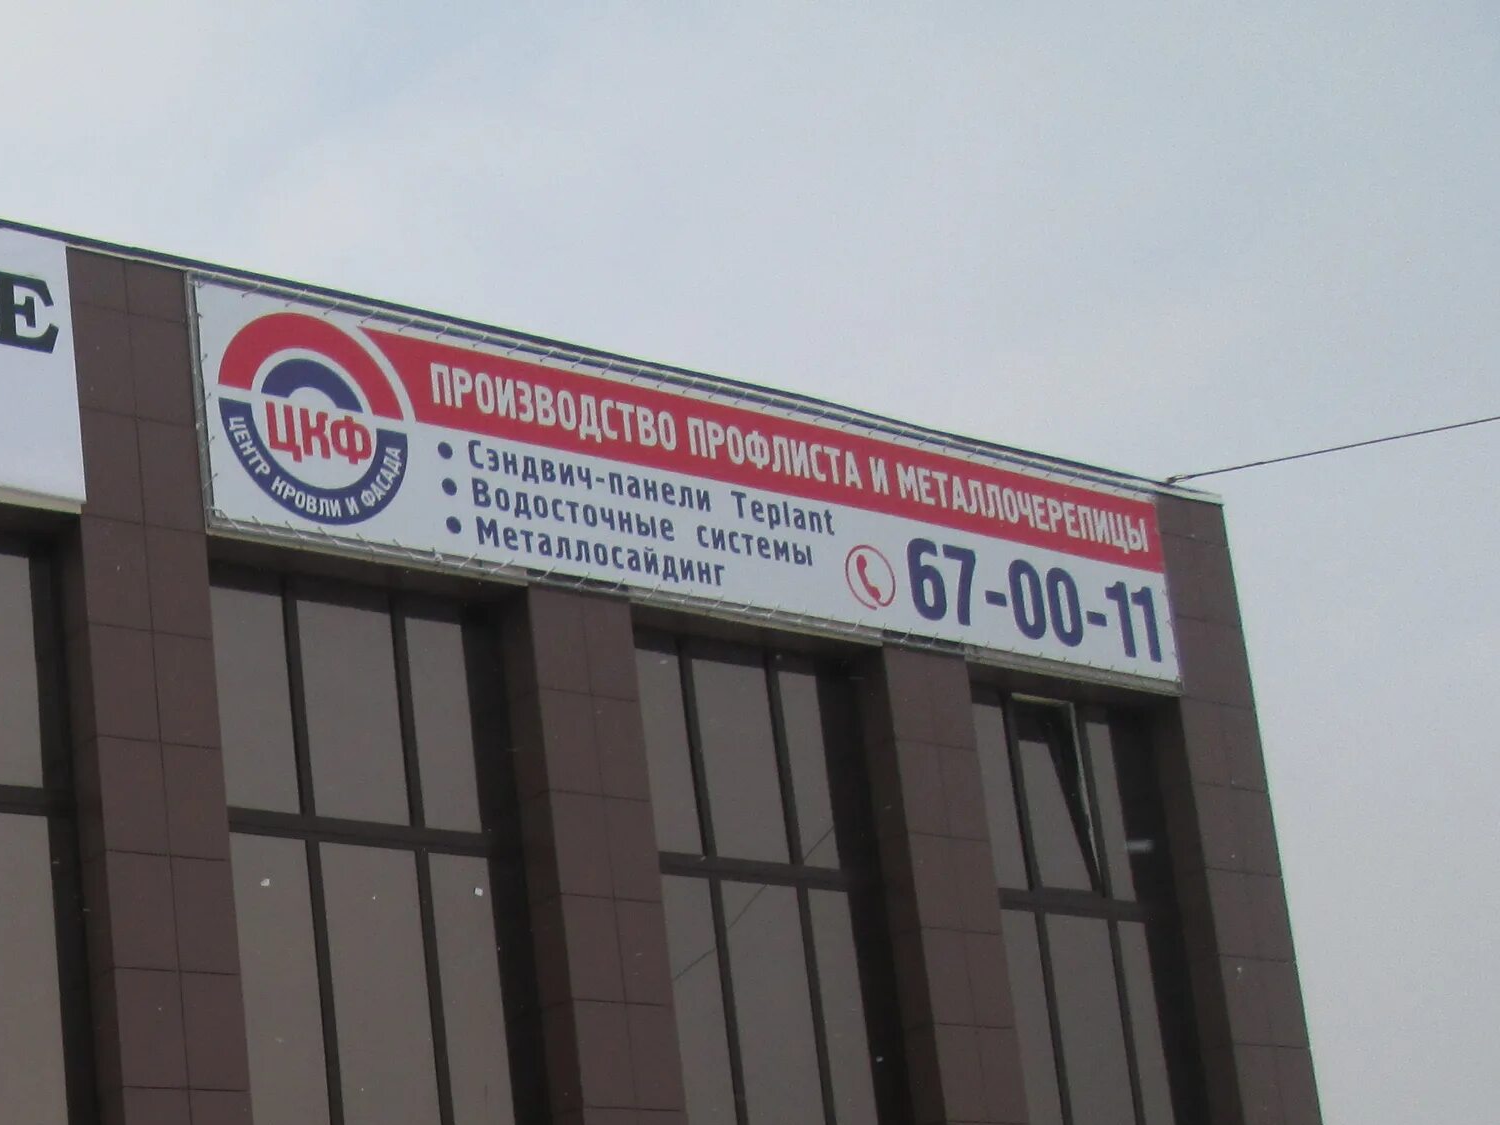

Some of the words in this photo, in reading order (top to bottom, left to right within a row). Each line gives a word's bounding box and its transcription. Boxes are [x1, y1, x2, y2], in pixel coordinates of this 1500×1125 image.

[228, 416, 272, 477] ЦЕНТР
[271, 475, 342, 518] КРОВЛИ
[346, 496, 360, 516] И
[360, 446, 404, 508] ФАСАДА
[265, 400, 373, 465] ЦКФ
[429, 361, 677, 452] ПРОИЗВОДСТВО
[687, 415, 862, 491] ПРОФЛИСТА
[868, 456, 890, 496] И
[896, 463, 1150, 555] МЕТАЛЛОЧЕРЕПИЦЫ
[467, 439, 712, 513] Сэндвич-панели
[730, 490, 837, 537] Teplant
[471, 476, 676, 542] Водосточные
[696, 522, 813, 567] системы
[475, 515, 726, 587] Металлосайдинг
[906, 537, 1163, 664] 67-00-11
